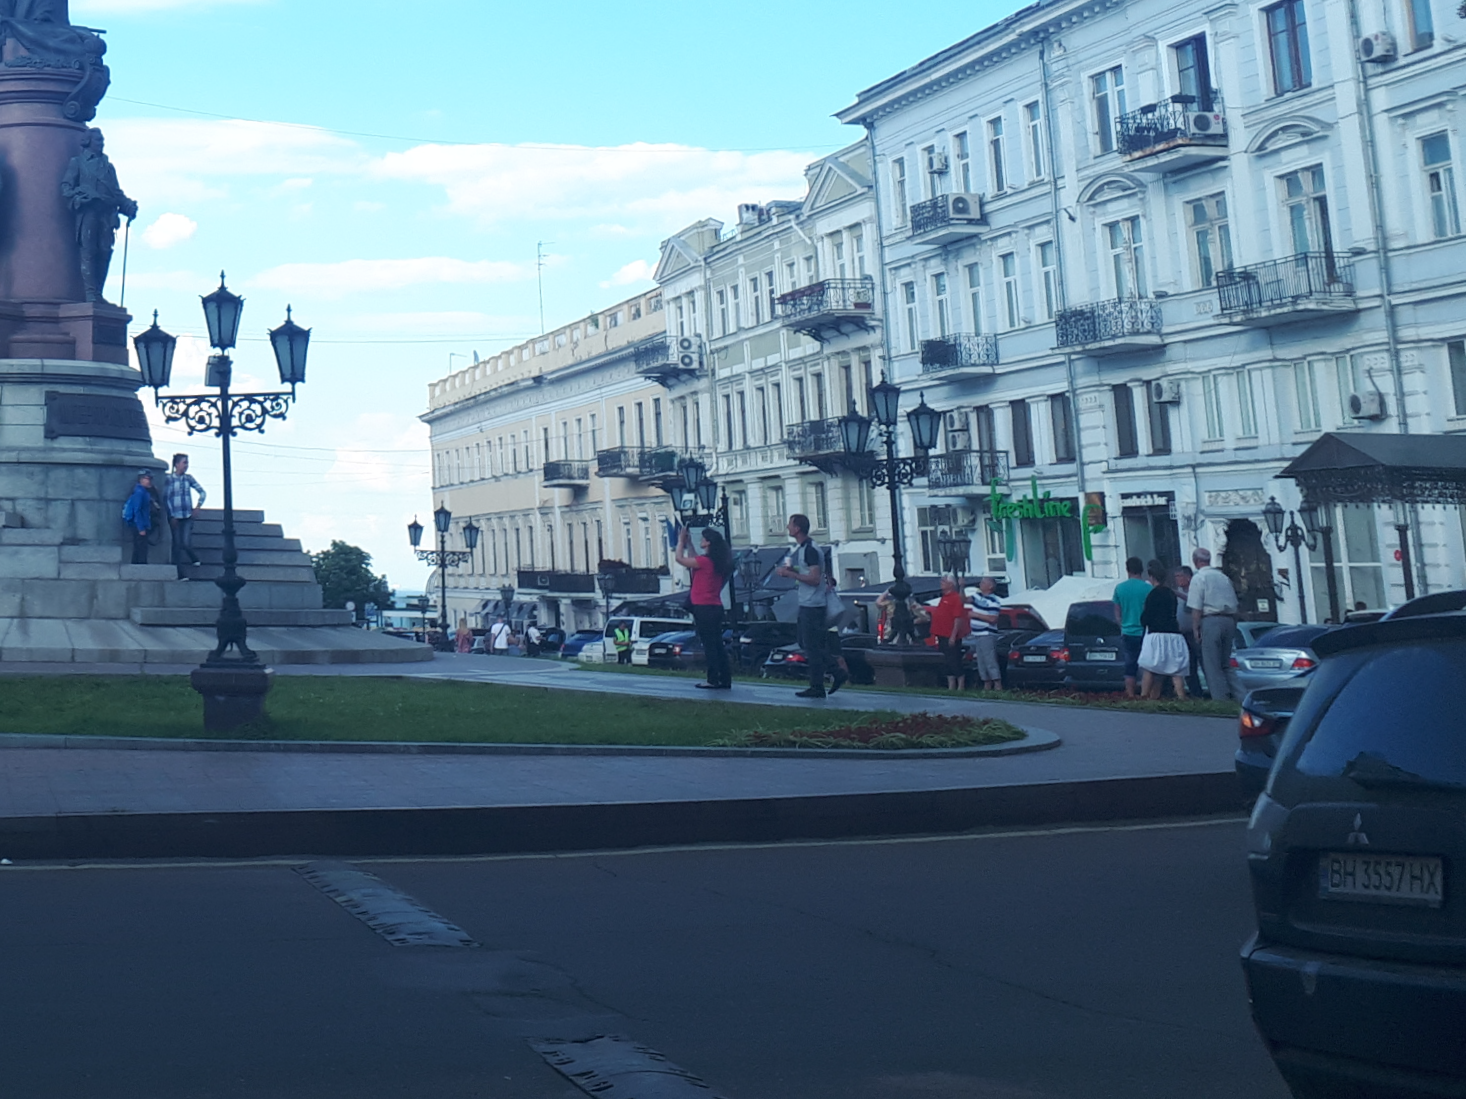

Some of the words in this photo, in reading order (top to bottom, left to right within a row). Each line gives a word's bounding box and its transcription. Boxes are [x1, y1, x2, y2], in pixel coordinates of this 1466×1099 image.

[1330, 858, 1357, 889] BH
[1361, 859, 1405, 892] 3557
[1409, 861, 1440, 896] HX
